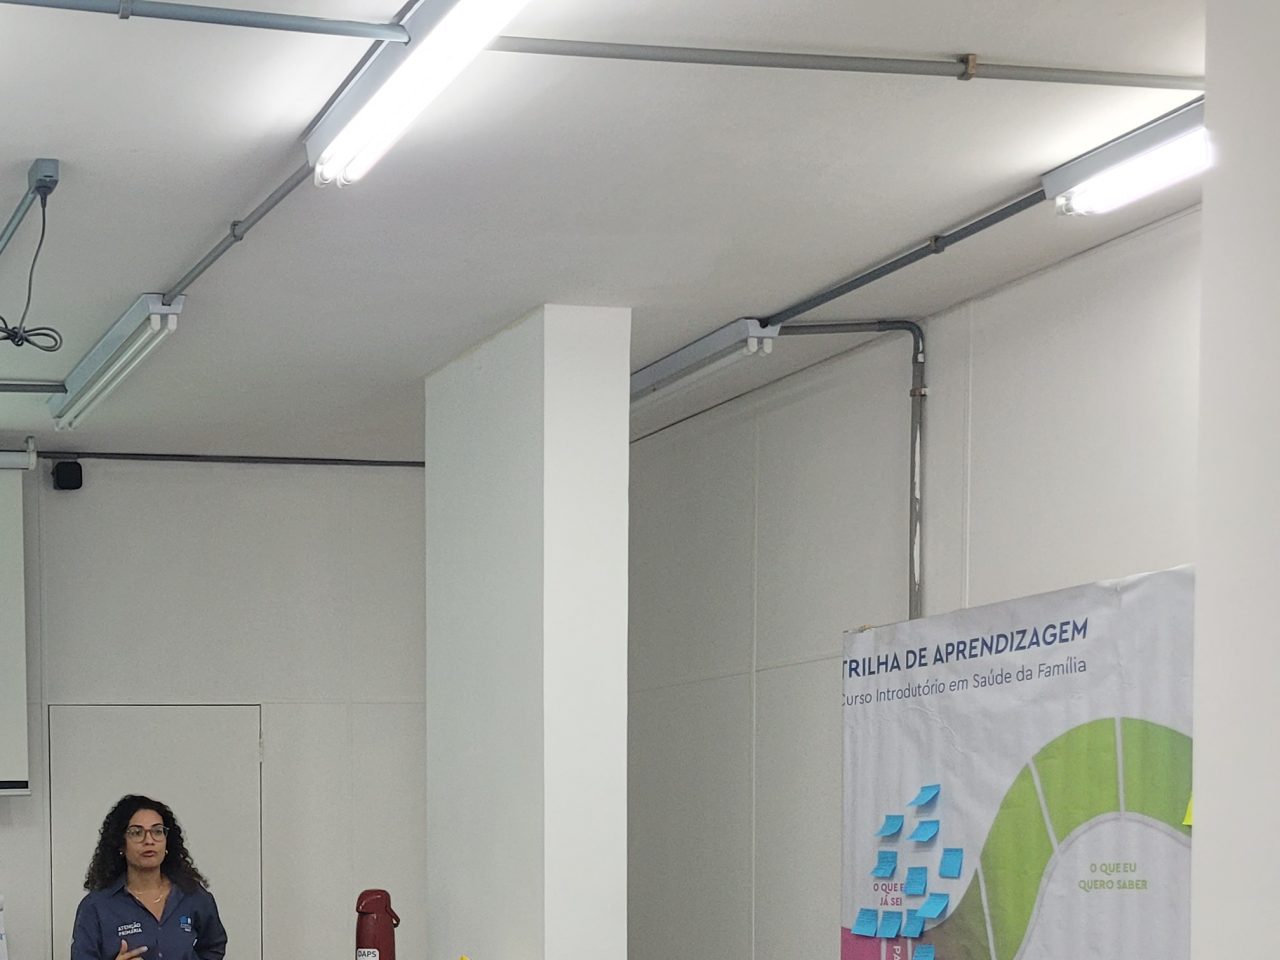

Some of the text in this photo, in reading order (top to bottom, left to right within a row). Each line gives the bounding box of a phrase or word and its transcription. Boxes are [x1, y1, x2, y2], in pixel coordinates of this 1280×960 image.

[906, 647, 928, 670] DE
[932, 617, 1089, 665] APRENDIZAGEM
[876, 678, 946, 703] Introdutório
[949, 678, 968, 692] em
[973, 668, 1012, 689] Saúde
[1016, 665, 1033, 682] da
[1037, 656, 1087, 679] Família
[1090, 863, 1137, 876] O QUE EU
[873, 883, 879, 892] O
[881, 883, 898, 894] QUE
[1078, 879, 1148, 893] QUERO SABER
[880, 894, 888, 906] JÁ
